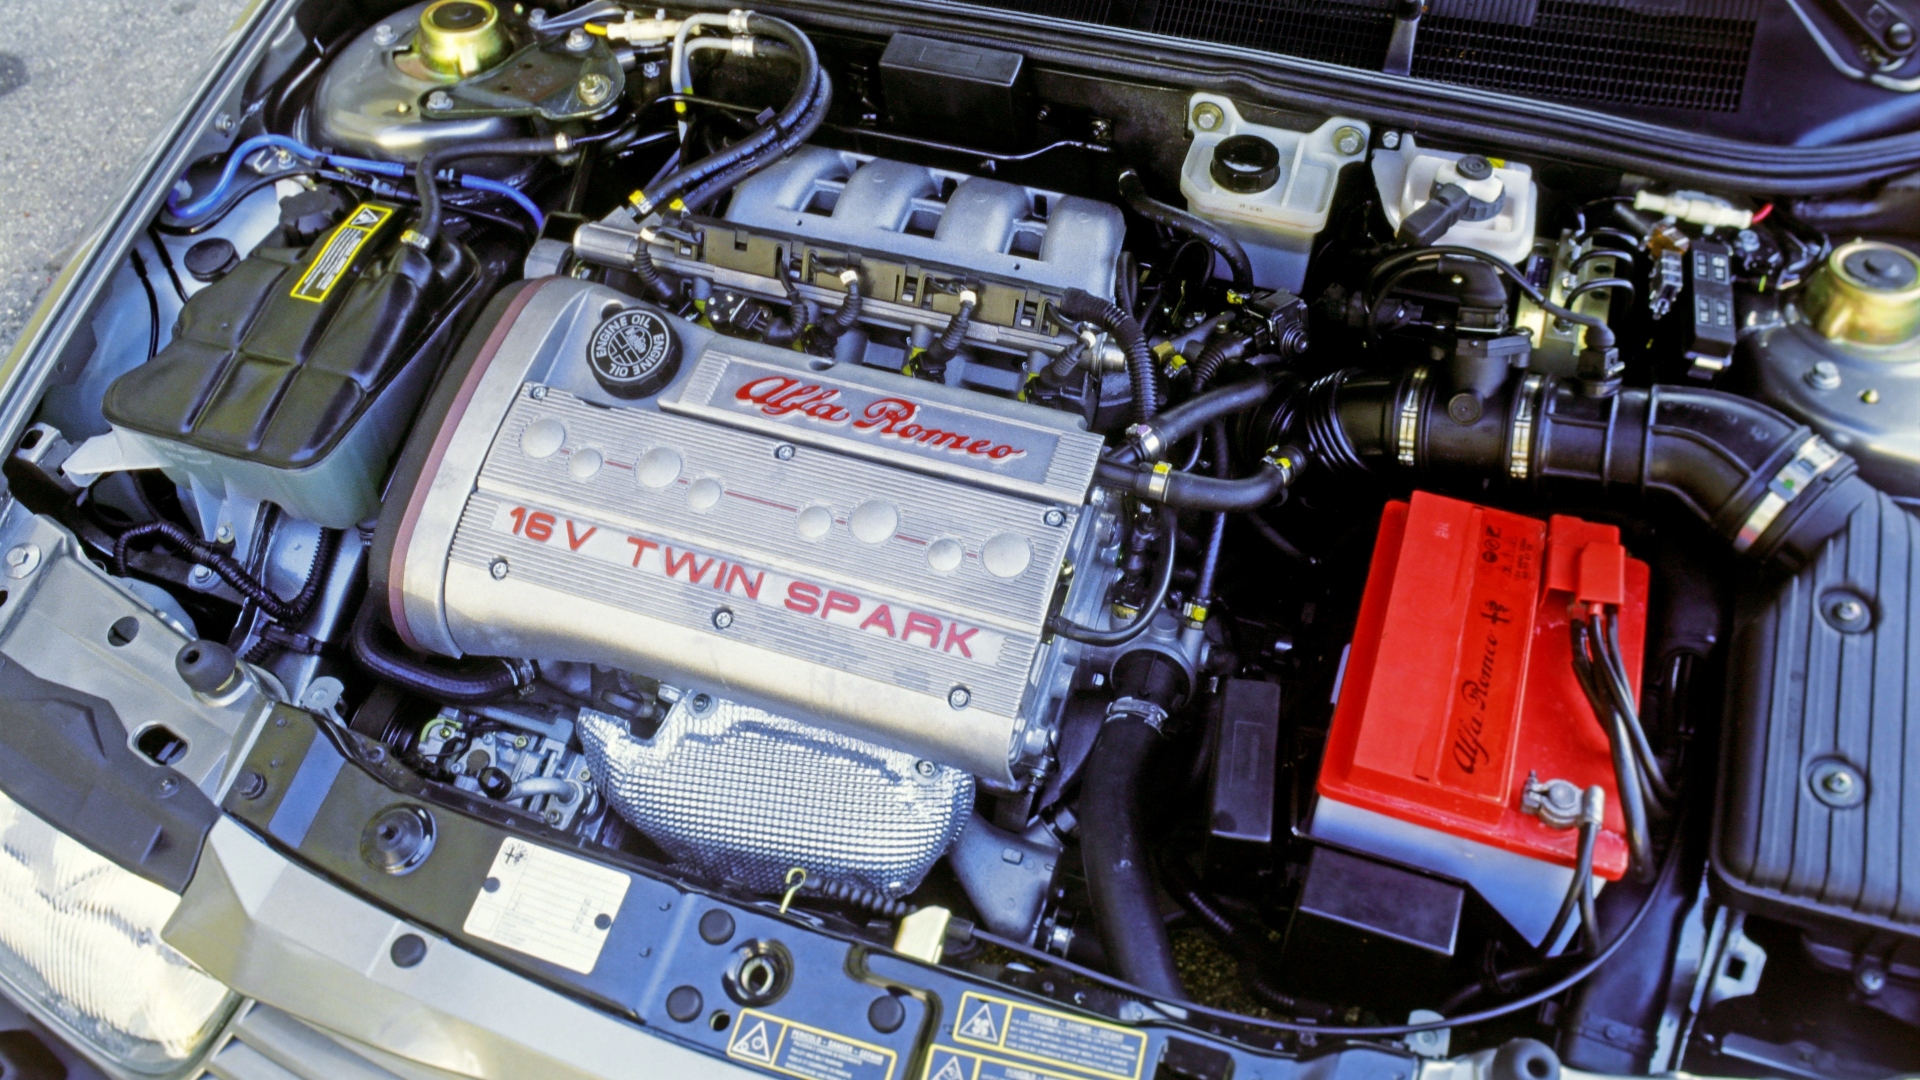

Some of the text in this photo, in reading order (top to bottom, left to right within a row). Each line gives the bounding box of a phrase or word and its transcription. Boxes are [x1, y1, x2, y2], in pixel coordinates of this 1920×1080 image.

[596, 315, 628, 358] ENGINE
[631, 314, 651, 329] OIL
[632, 333, 665, 376] ENGINE
[609, 363, 629, 377] OIL
[735, 376, 1026, 461] Alfa Romeo
[627, 536, 764, 600] TWIN
[784, 581, 980, 659] SPARK
[1453, 633, 1497, 774] Alfa Romeo
